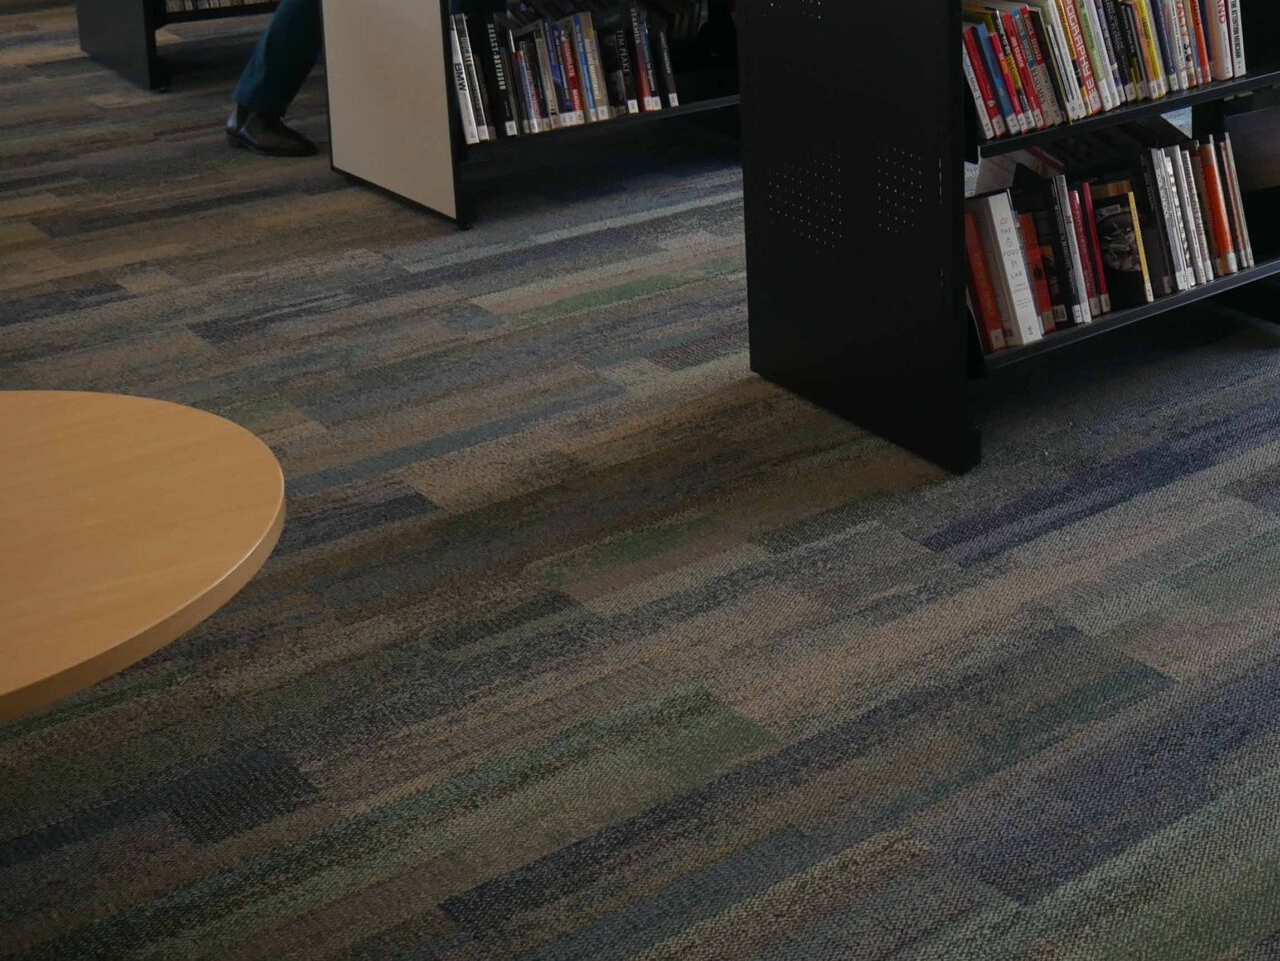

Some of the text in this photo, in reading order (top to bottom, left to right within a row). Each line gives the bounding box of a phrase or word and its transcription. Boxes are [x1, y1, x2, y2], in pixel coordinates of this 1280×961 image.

[1230, 0, 1238, 9] THE
[629, 7, 642, 45] STARMUS
[1230, 9, 1241, 35] ATTENTION
[616, 29, 626, 46] TIM
[486, 22, 507, 91] HARLEY-DAVIDSON
[453, 62, 467, 92] BMW
[1155, 168, 1170, 219] TOOL SCHOOL
